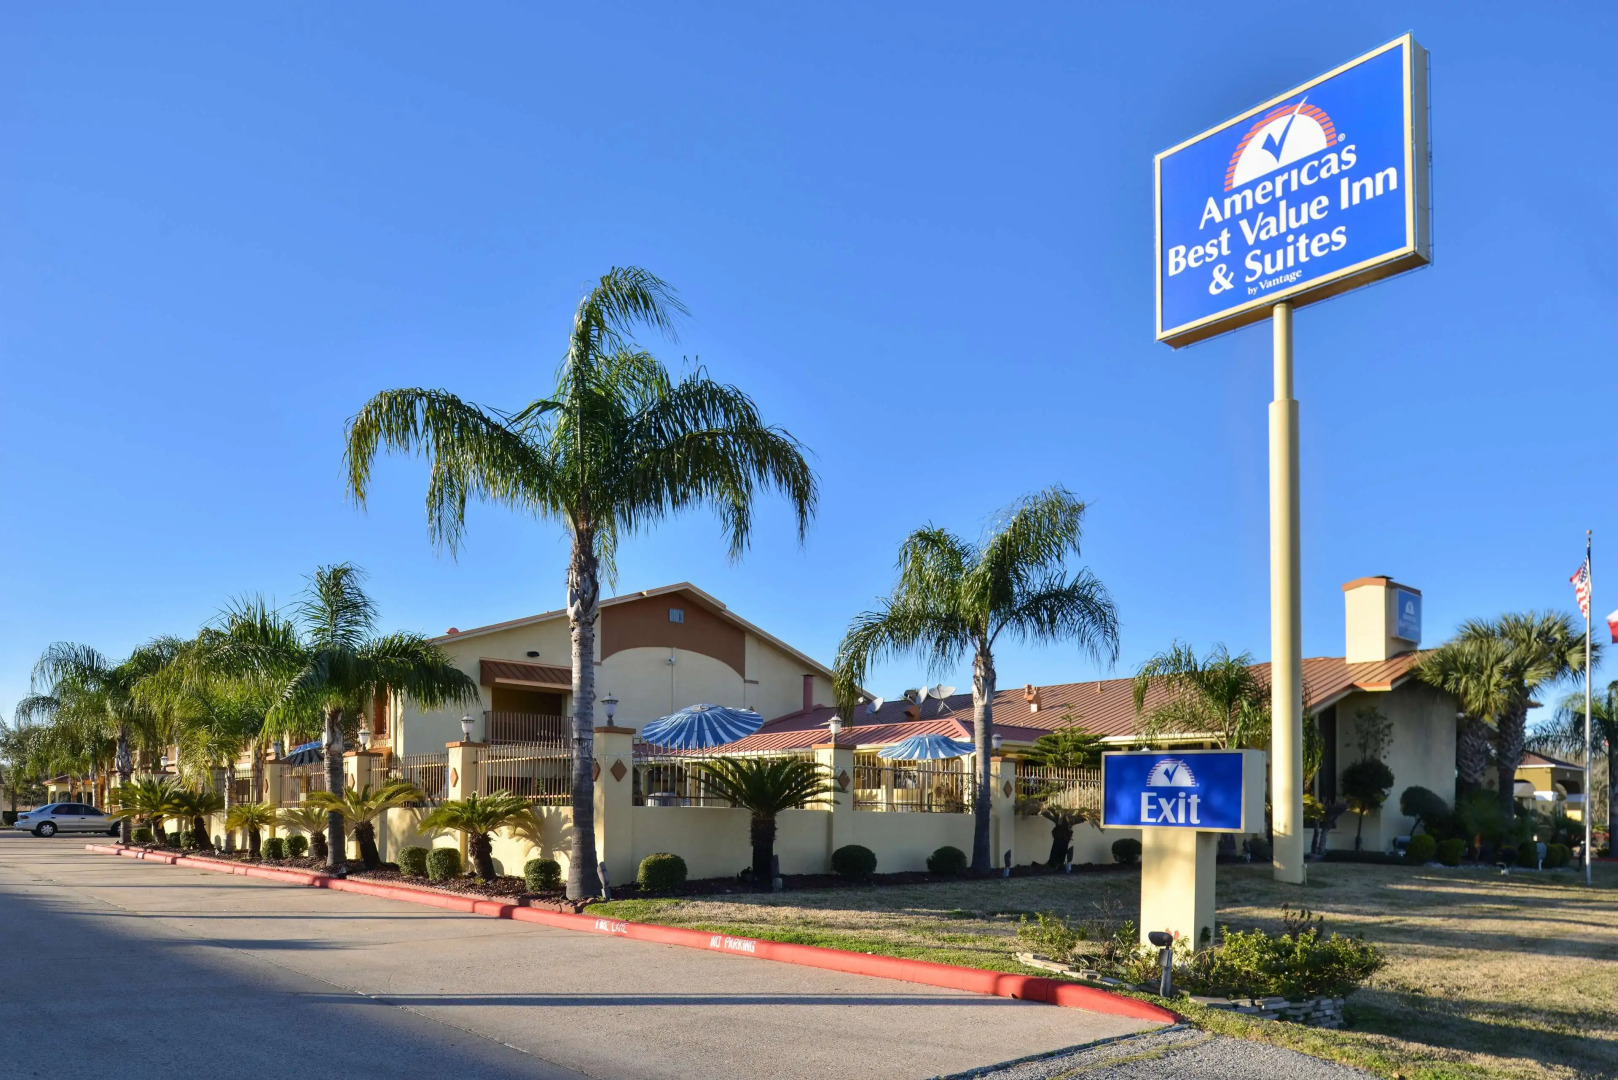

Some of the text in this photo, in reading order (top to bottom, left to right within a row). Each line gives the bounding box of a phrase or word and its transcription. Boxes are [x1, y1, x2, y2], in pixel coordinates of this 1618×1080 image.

[1199, 144, 1356, 230] Americas
[1168, 167, 1398, 277] Best Value Inn
[1208, 225, 1347, 296] & Suites
[1247, 269, 1302, 296] by Vantage
[1140, 792, 1201, 825] Exit
[710, 935, 756, 953] NO PARKING
